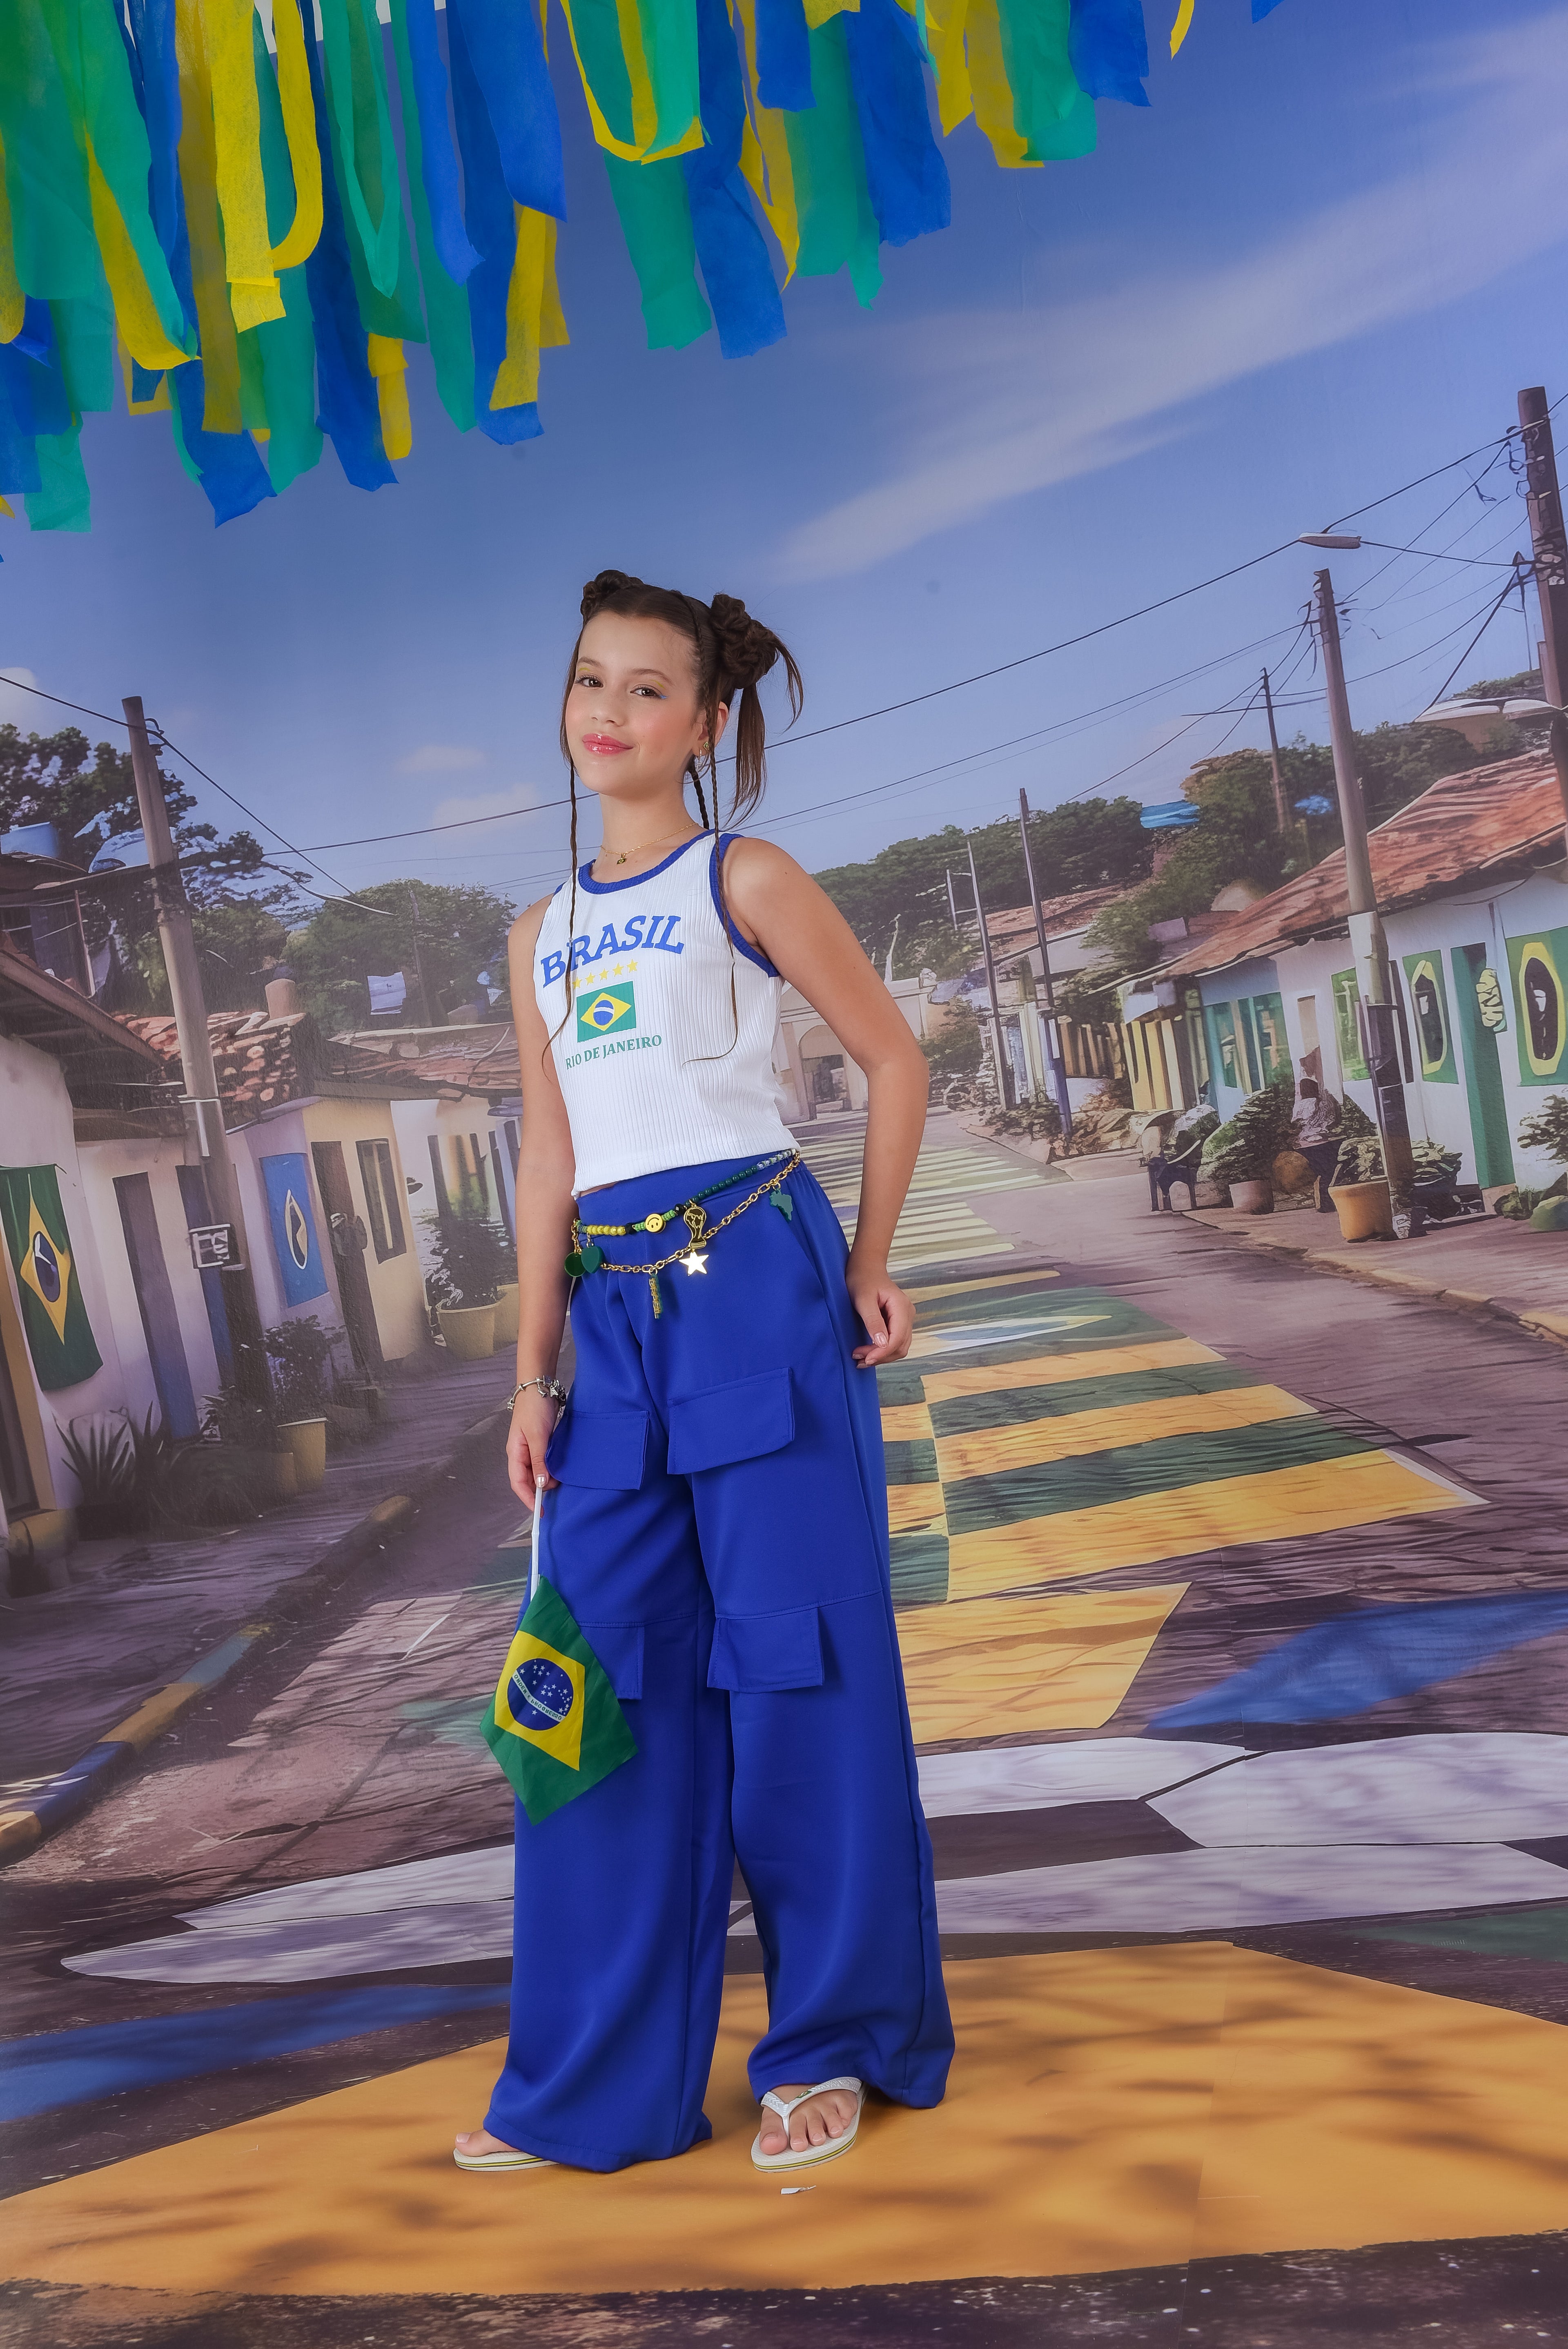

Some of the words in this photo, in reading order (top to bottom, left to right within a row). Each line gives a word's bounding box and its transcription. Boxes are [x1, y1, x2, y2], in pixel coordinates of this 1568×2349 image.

[541, 915, 684, 988] BRASIL
[565, 1053, 581, 1070] RIO
[584, 1047, 600, 1062] DE
[602, 1035, 662, 1059] JANEIRO
